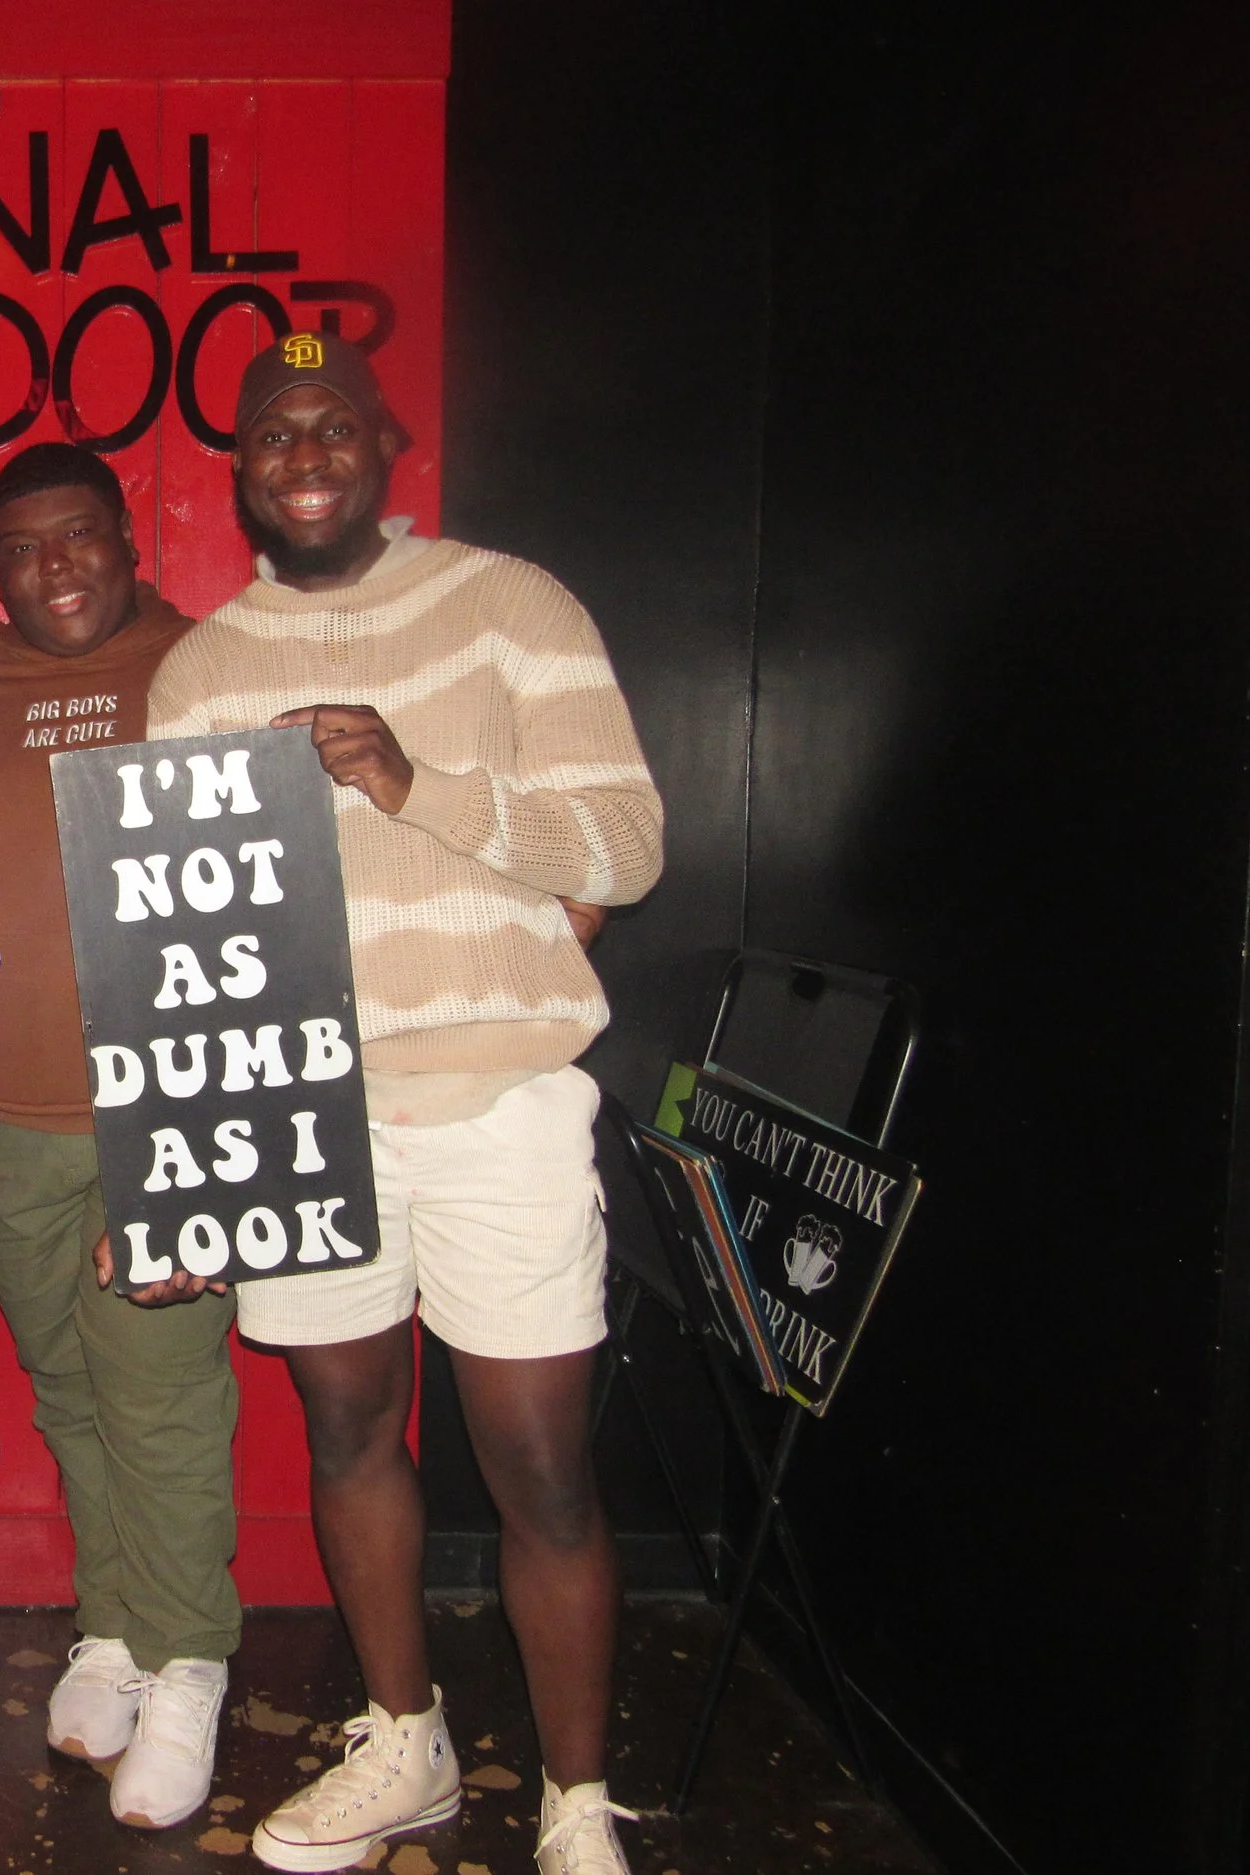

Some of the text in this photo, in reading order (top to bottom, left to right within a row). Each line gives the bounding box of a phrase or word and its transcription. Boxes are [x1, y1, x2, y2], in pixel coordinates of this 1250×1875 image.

[23, 727, 62, 748] ARE
[26, 694, 118, 722] BIG BOYS
[116, 750, 262, 829] I'M
[111, 838, 285, 923] NOT
[153, 934, 268, 1010] AS
[91, 1017, 353, 1108] DUMB
[143, 1111, 326, 1193] AS I
[689, 1087, 899, 1228] YOU CAN'T THINK
[123, 1197, 363, 1284] LOOK
[738, 1193, 771, 1242] IF
